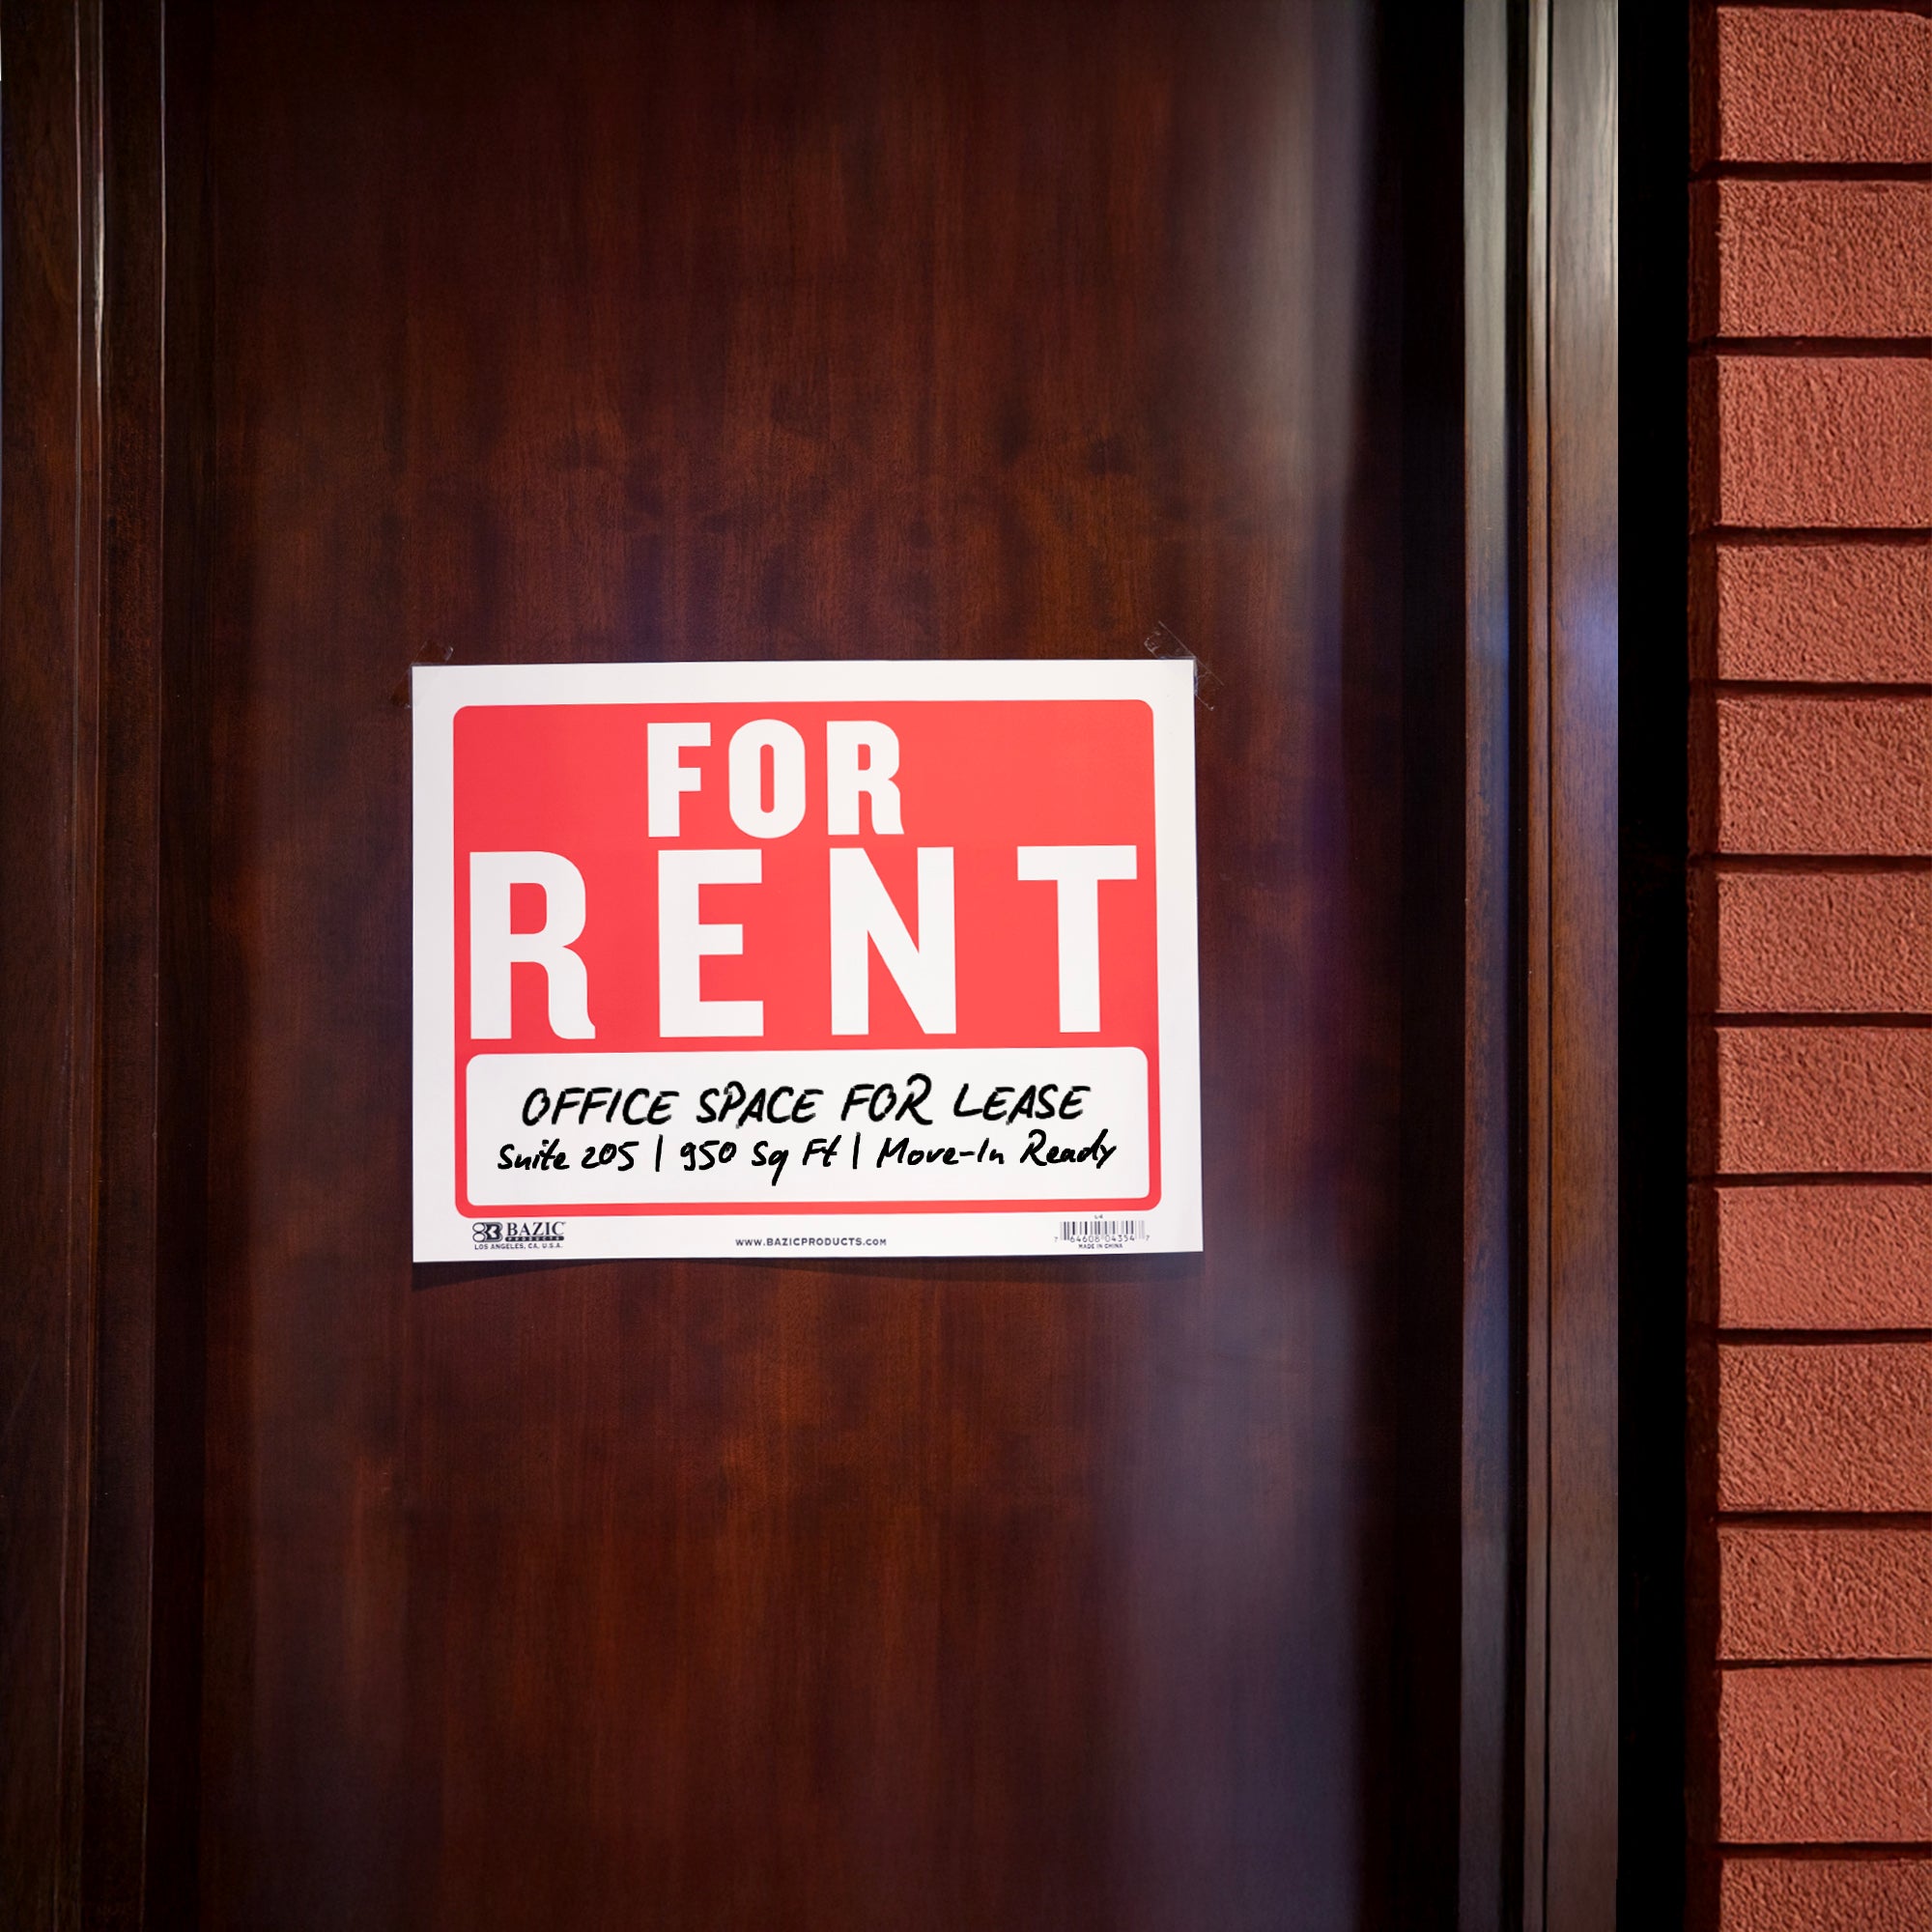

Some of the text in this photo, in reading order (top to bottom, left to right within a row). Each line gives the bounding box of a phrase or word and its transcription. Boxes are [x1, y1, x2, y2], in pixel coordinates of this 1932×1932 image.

[647, 720, 903, 838] FOR
[470, 845, 1137, 1041] RENT
[522, 1073, 1091, 1128] OFFICE SPACE FOR LEASE
[497, 1139, 570, 1171] Suite
[581, 1141, 639, 1172] 205
[680, 1140, 736, 1172] 950
[751, 1140, 790, 1186] Sq
[803, 1135, 841, 1167] Ft
[876, 1137, 1005, 1168] Move-In
[1019, 1128, 1117, 1169] Ready
[507, 1221, 564, 1236] BAZIC
